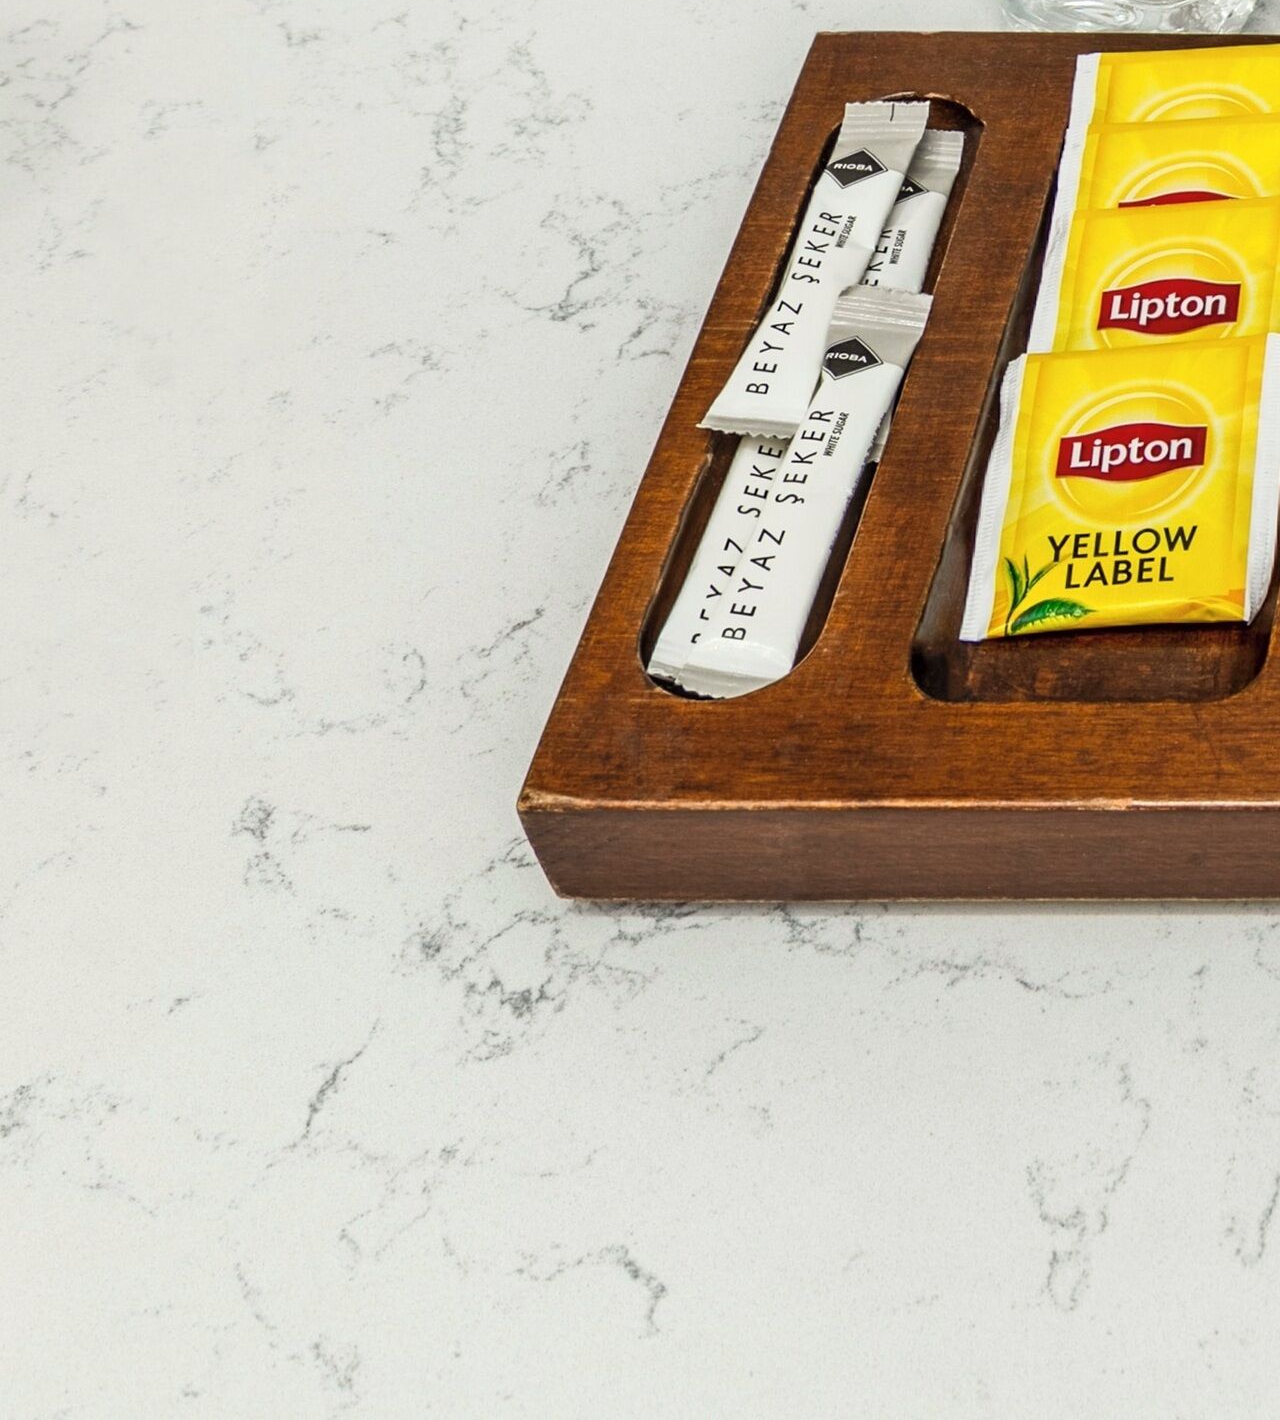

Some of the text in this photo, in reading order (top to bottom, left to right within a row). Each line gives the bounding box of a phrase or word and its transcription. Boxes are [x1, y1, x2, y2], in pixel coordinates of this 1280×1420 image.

[833, 163, 873, 172] RIOBA
[745, 211, 843, 395] BEYAZ ŞEKER
[1109, 291, 1227, 326] Lipton
[825, 352, 868, 363] RIOBA
[1069, 436, 1193, 474] Lipton
[721, 410, 835, 641] BEYAZ ŞEKER
[1047, 525, 1199, 562] YELLOW
[1065, 555, 1175, 591] LABEL
